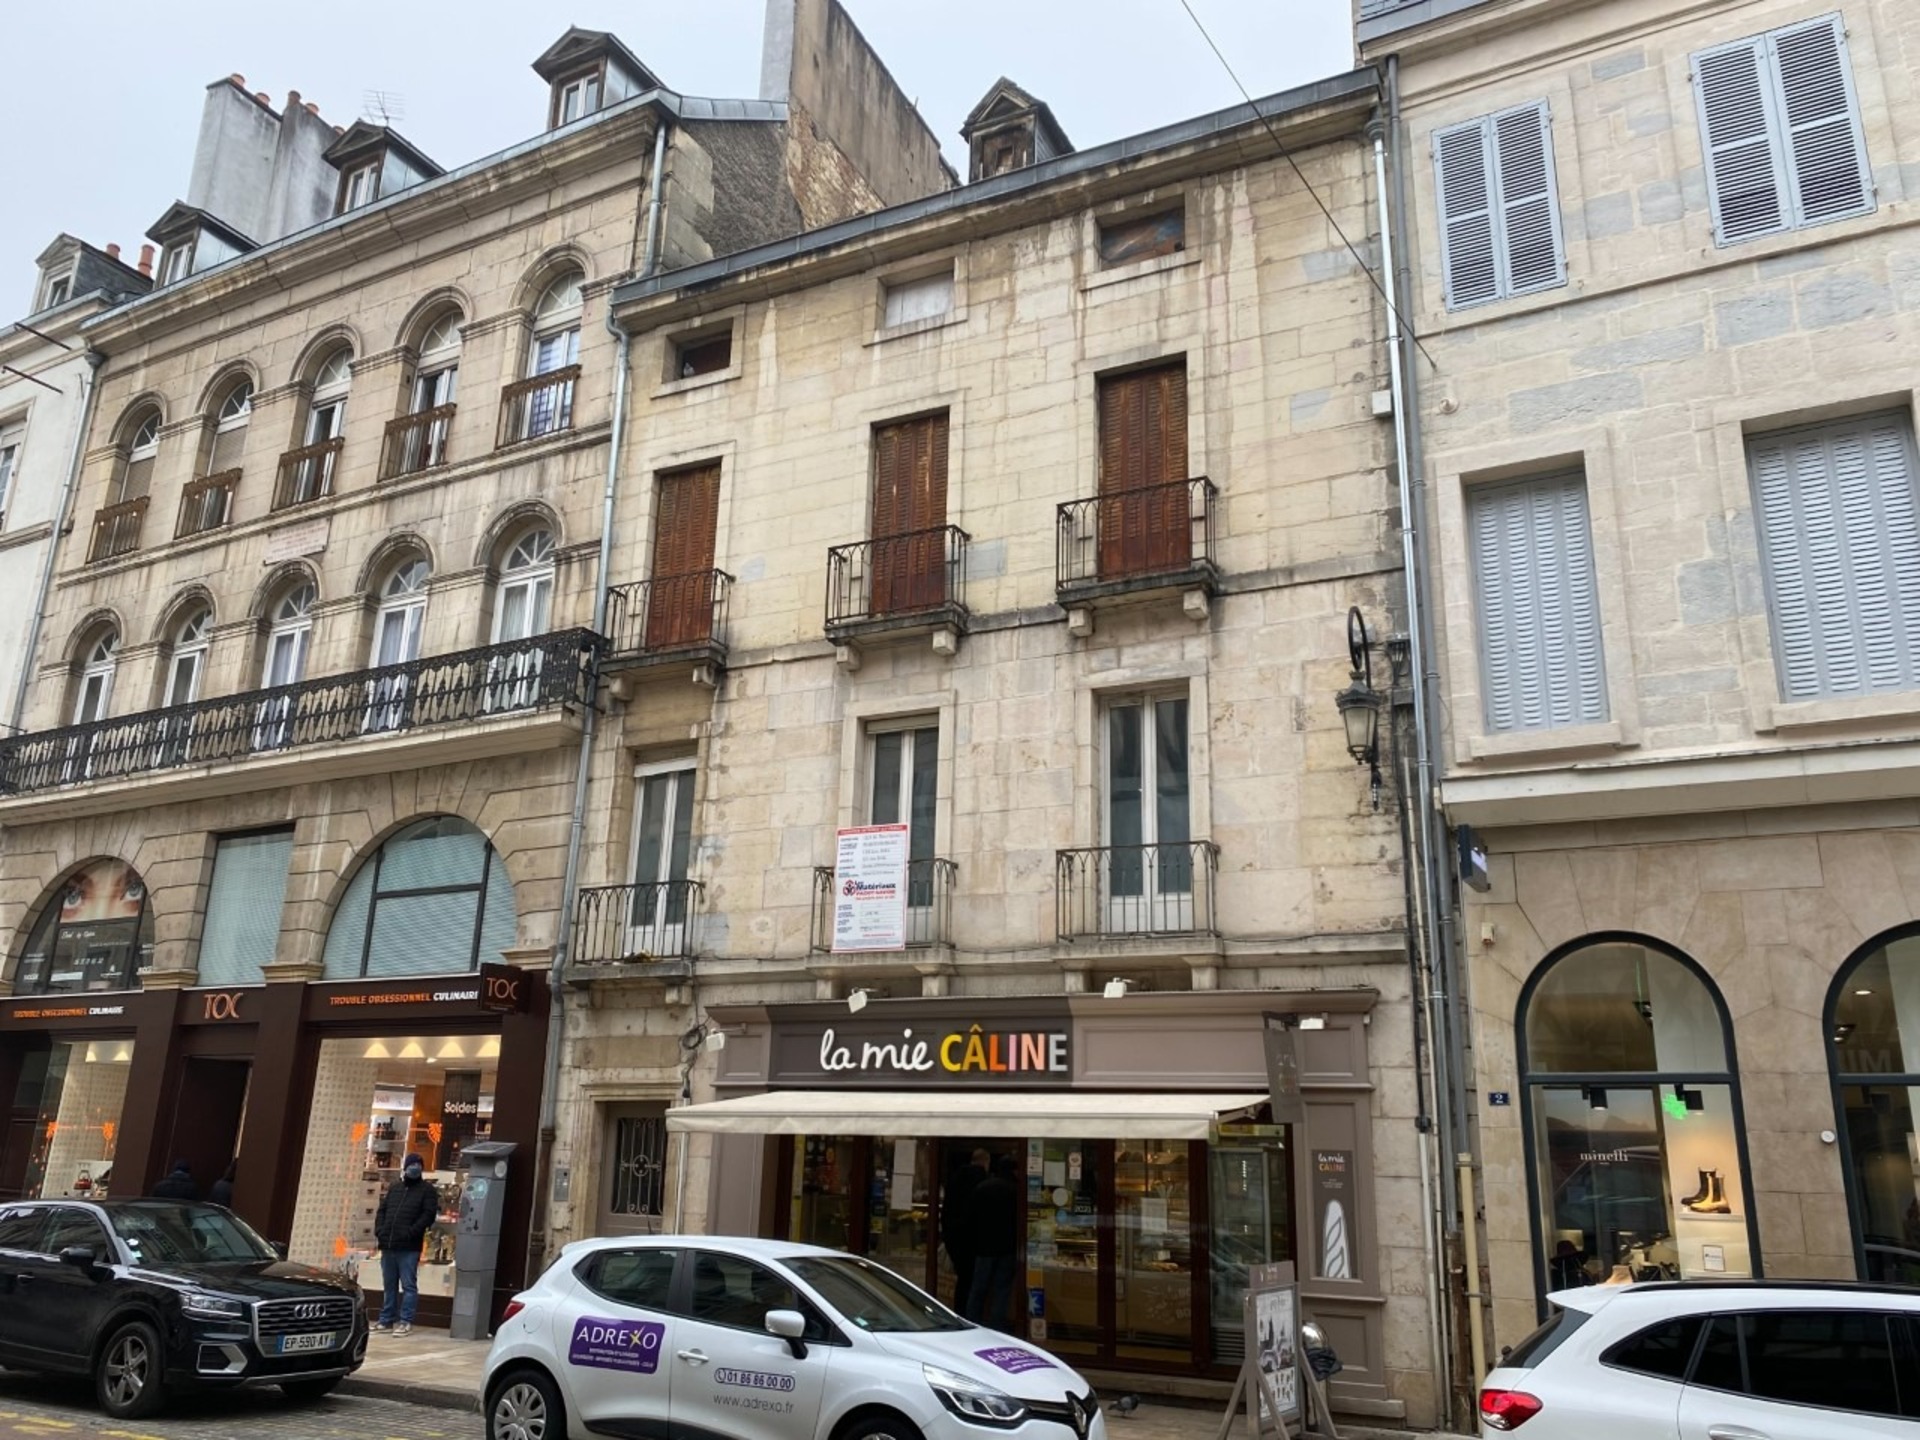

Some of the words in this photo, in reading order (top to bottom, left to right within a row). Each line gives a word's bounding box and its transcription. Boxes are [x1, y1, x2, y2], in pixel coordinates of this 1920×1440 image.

[486, 977, 518, 1000] TOC
[204, 992, 243, 1019] TOC
[330, 996, 367, 1006] TROUBLE
[368, 993, 431, 1003] OBSESSIONNEL
[819, 1028, 856, 1071] la
[860, 1028, 934, 1071] mie
[940, 1023, 1068, 1072] CÂLINE
[444, 1101, 477, 1114] Soldes
[1494, 1093, 1504, 1104] 2
[1580, 1150, 1629, 1162] minelli
[577, 1325, 657, 1350] ADREXO
[727, 1371, 737, 1382] 01
[766, 1376, 778, 1387] 00
[780, 1378, 791, 1389] 00
[713, 1394, 794, 1414] www.adrexo.fr
